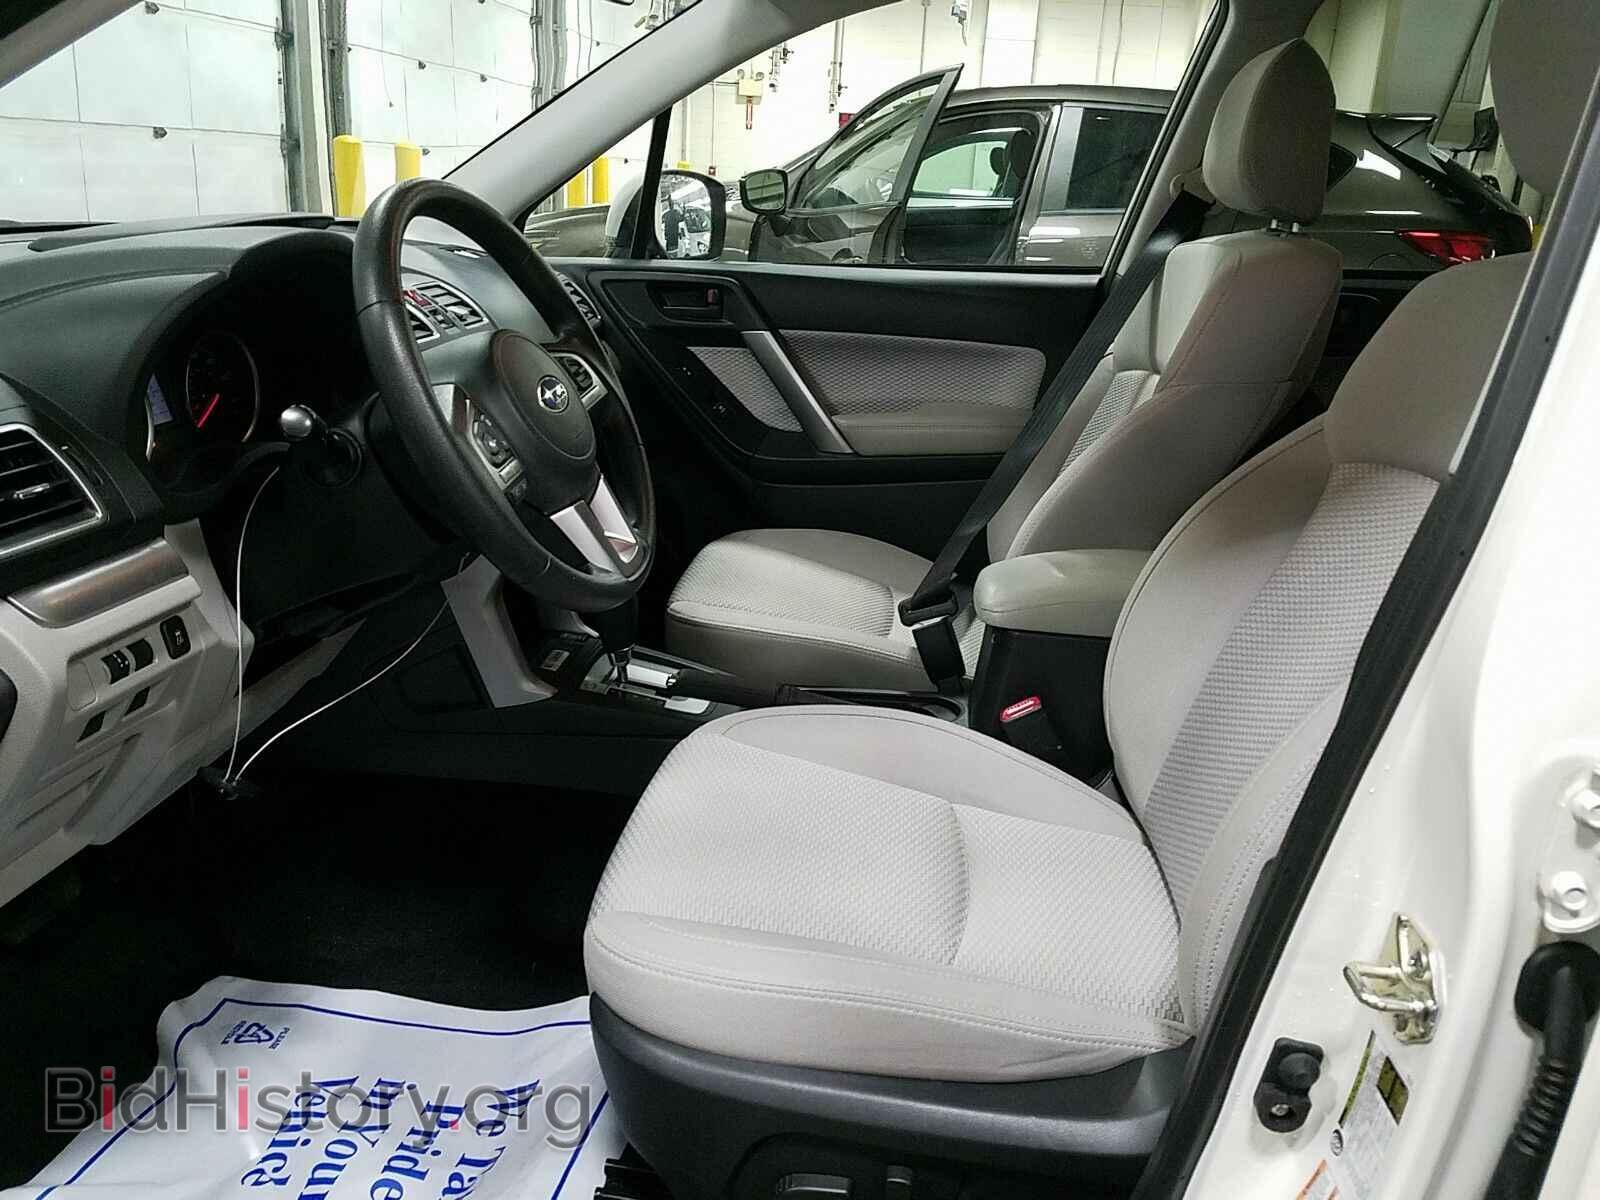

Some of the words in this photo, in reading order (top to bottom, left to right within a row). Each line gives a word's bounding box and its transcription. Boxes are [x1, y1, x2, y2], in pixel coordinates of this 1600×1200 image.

[360, 1078, 417, 1111] in
[475, 1079, 541, 1138] We
[370, 1100, 468, 1200] Pride
[442, 1146, 508, 1200] Ta
